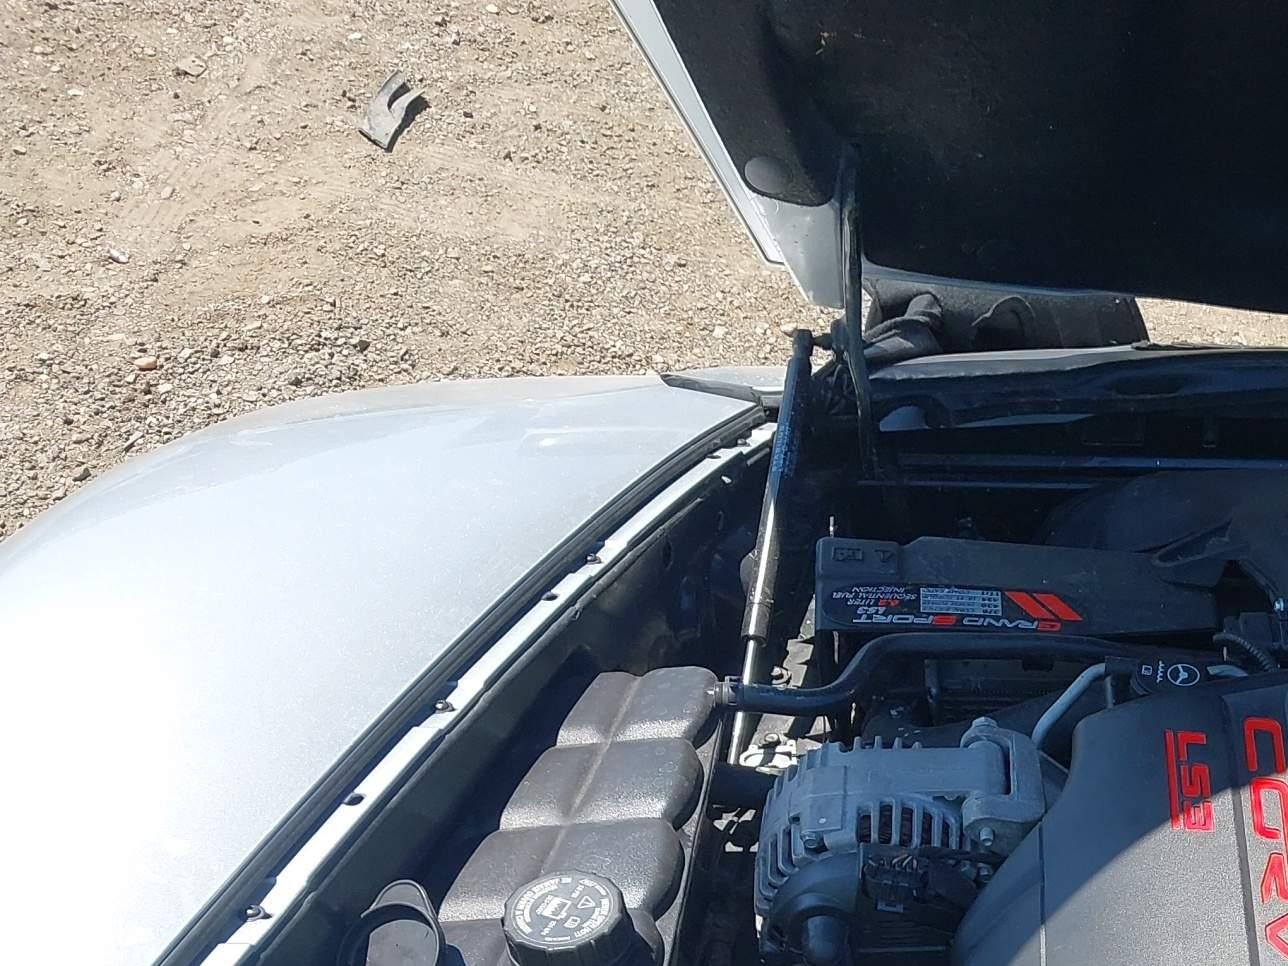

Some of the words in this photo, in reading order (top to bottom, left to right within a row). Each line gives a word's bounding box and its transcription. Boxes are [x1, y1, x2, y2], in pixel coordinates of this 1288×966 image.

[856, 606, 886, 614] LS3
[853, 614, 957, 625] SPORT
[962, 617, 1061, 631] GRAND
[1176, 730, 1215, 832] LS3
